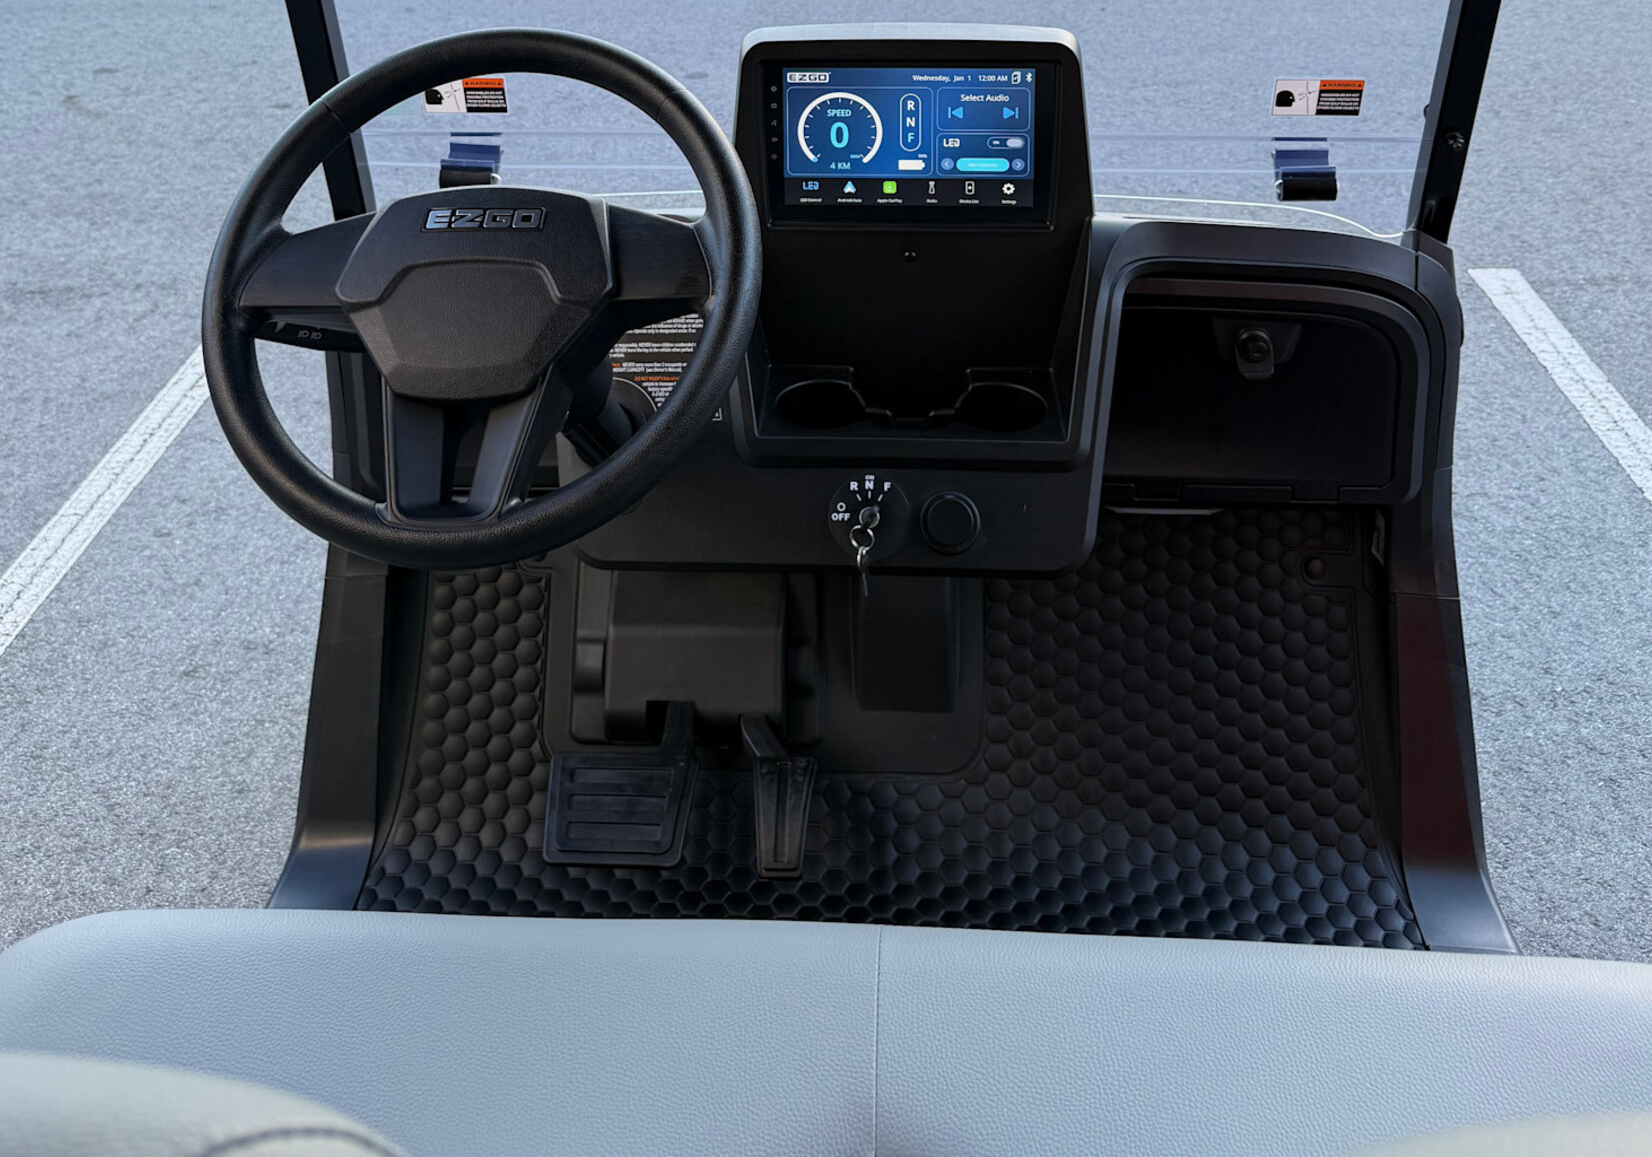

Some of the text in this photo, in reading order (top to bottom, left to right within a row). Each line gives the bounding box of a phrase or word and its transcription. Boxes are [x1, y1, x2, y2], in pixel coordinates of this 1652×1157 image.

[788, 73, 828, 82] EZGO
[912, 74, 951, 82] Wednesday,
[953, 74, 964, 82] Jan
[978, 74, 995, 82] 12:00
[996, 74, 1008, 82] AM
[960, 93, 1010, 102] Select Audio
[907, 100, 916, 111] R
[827, 109, 852, 117] SPEED
[906, 117, 915, 127] N
[830, 121, 849, 149] 0
[908, 133, 915, 143] F
[943, 138, 960, 148] LED
[829, 162, 851, 170] 4 KM
[802, 181, 820, 190] LED
[425, 209, 542, 229] EZGO
[850, 480, 892, 492] R N F
[831, 513, 850, 521] OFF
